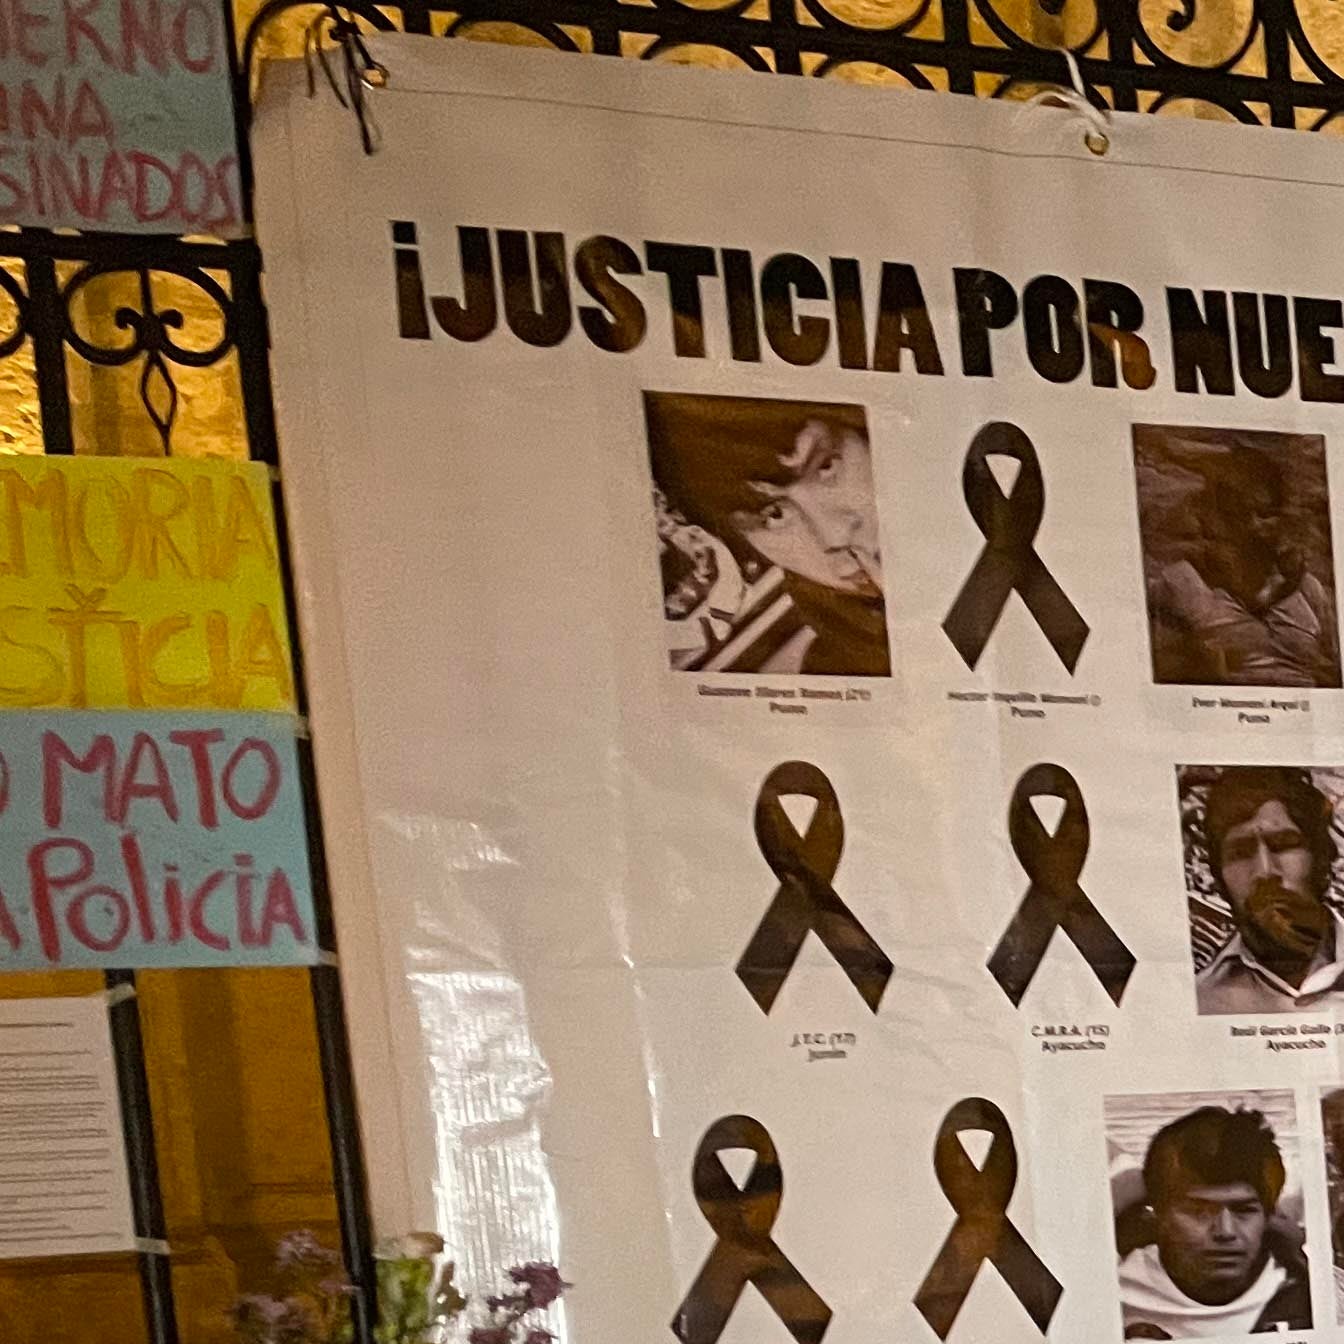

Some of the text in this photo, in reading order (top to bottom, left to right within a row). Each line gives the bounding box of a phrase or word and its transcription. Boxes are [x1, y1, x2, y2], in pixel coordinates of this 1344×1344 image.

[952, 267, 1157, 392] POR
[41, 728, 282, 831] MATO
[1265, 1039, 1326, 1052] Ayacucho
